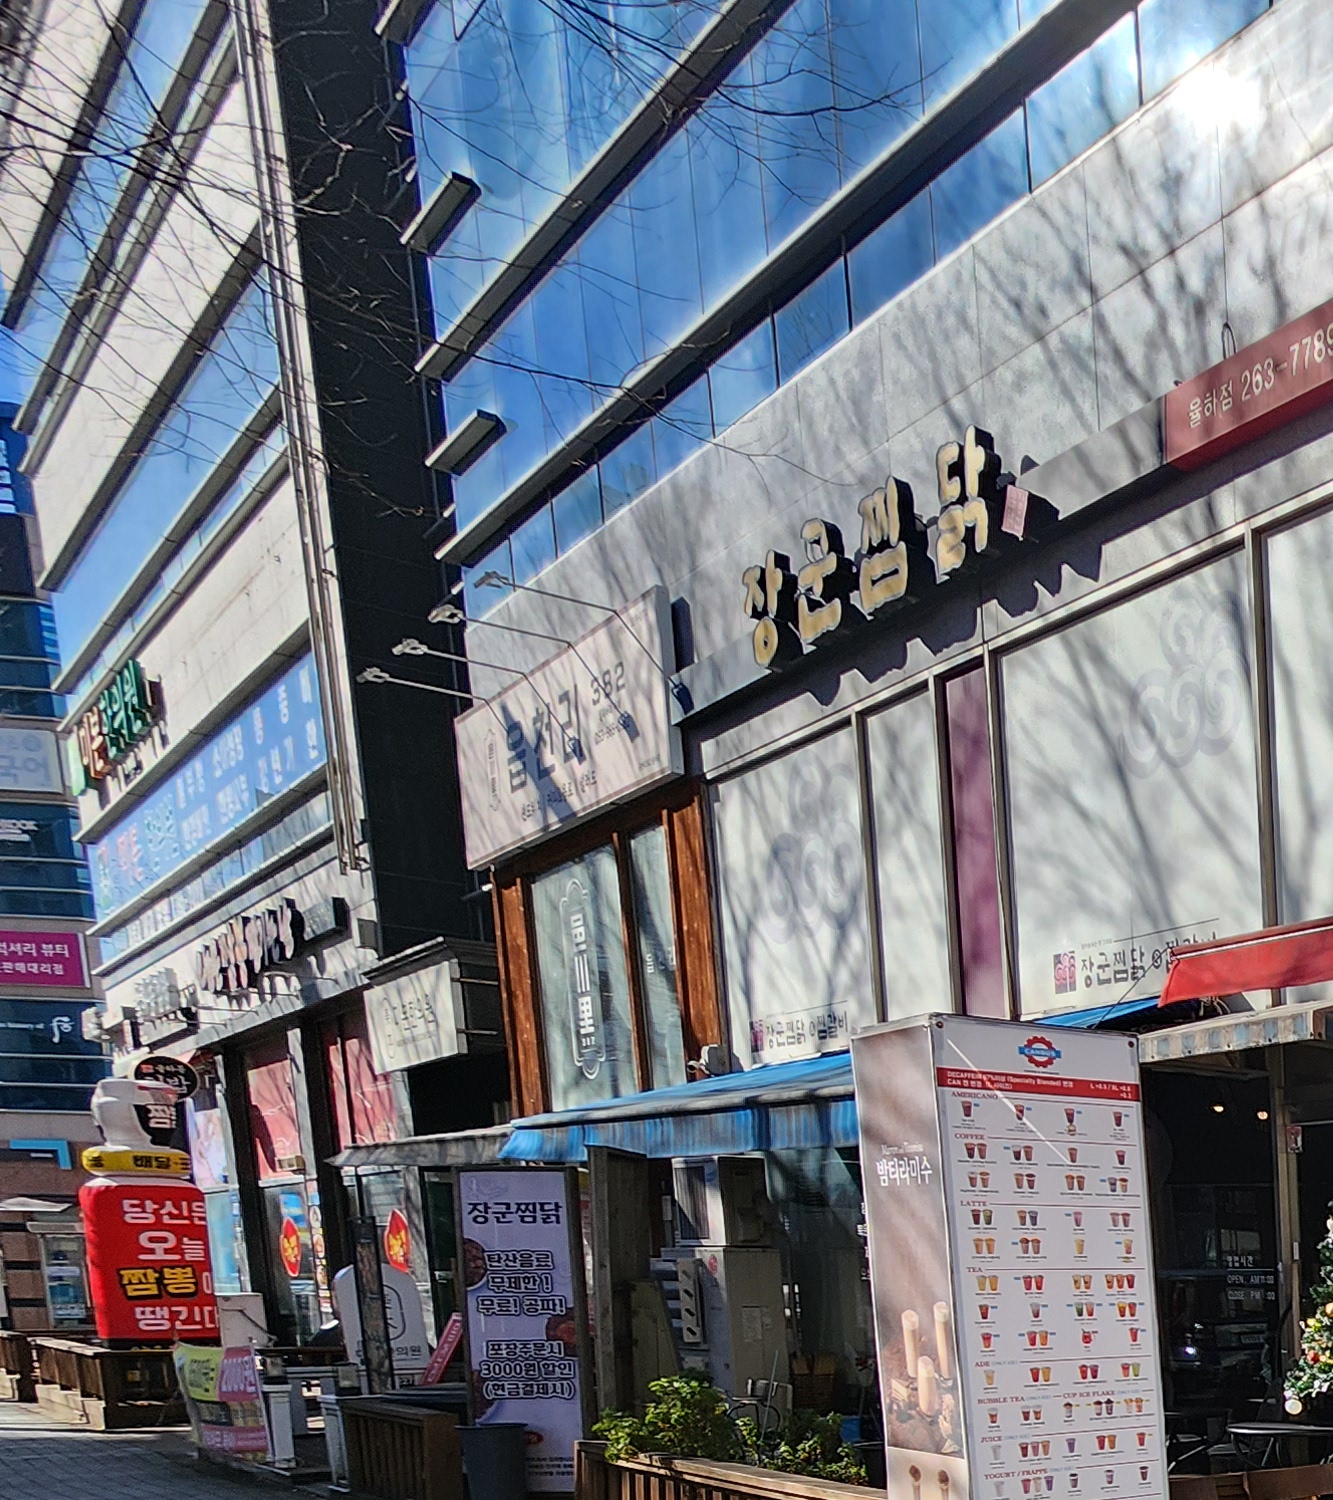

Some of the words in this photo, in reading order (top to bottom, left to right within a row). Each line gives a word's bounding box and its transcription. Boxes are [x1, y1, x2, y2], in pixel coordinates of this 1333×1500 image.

[742, 425, 988, 668] 장군찜닭
[590, 661, 627, 706] 382
[467, 1201, 563, 1225] 장군찜닭
[485, 1250, 553, 1270] 탄산음료
[480, 1361, 538, 1378] 3000원
[540, 1360, 575, 1379] 할인
